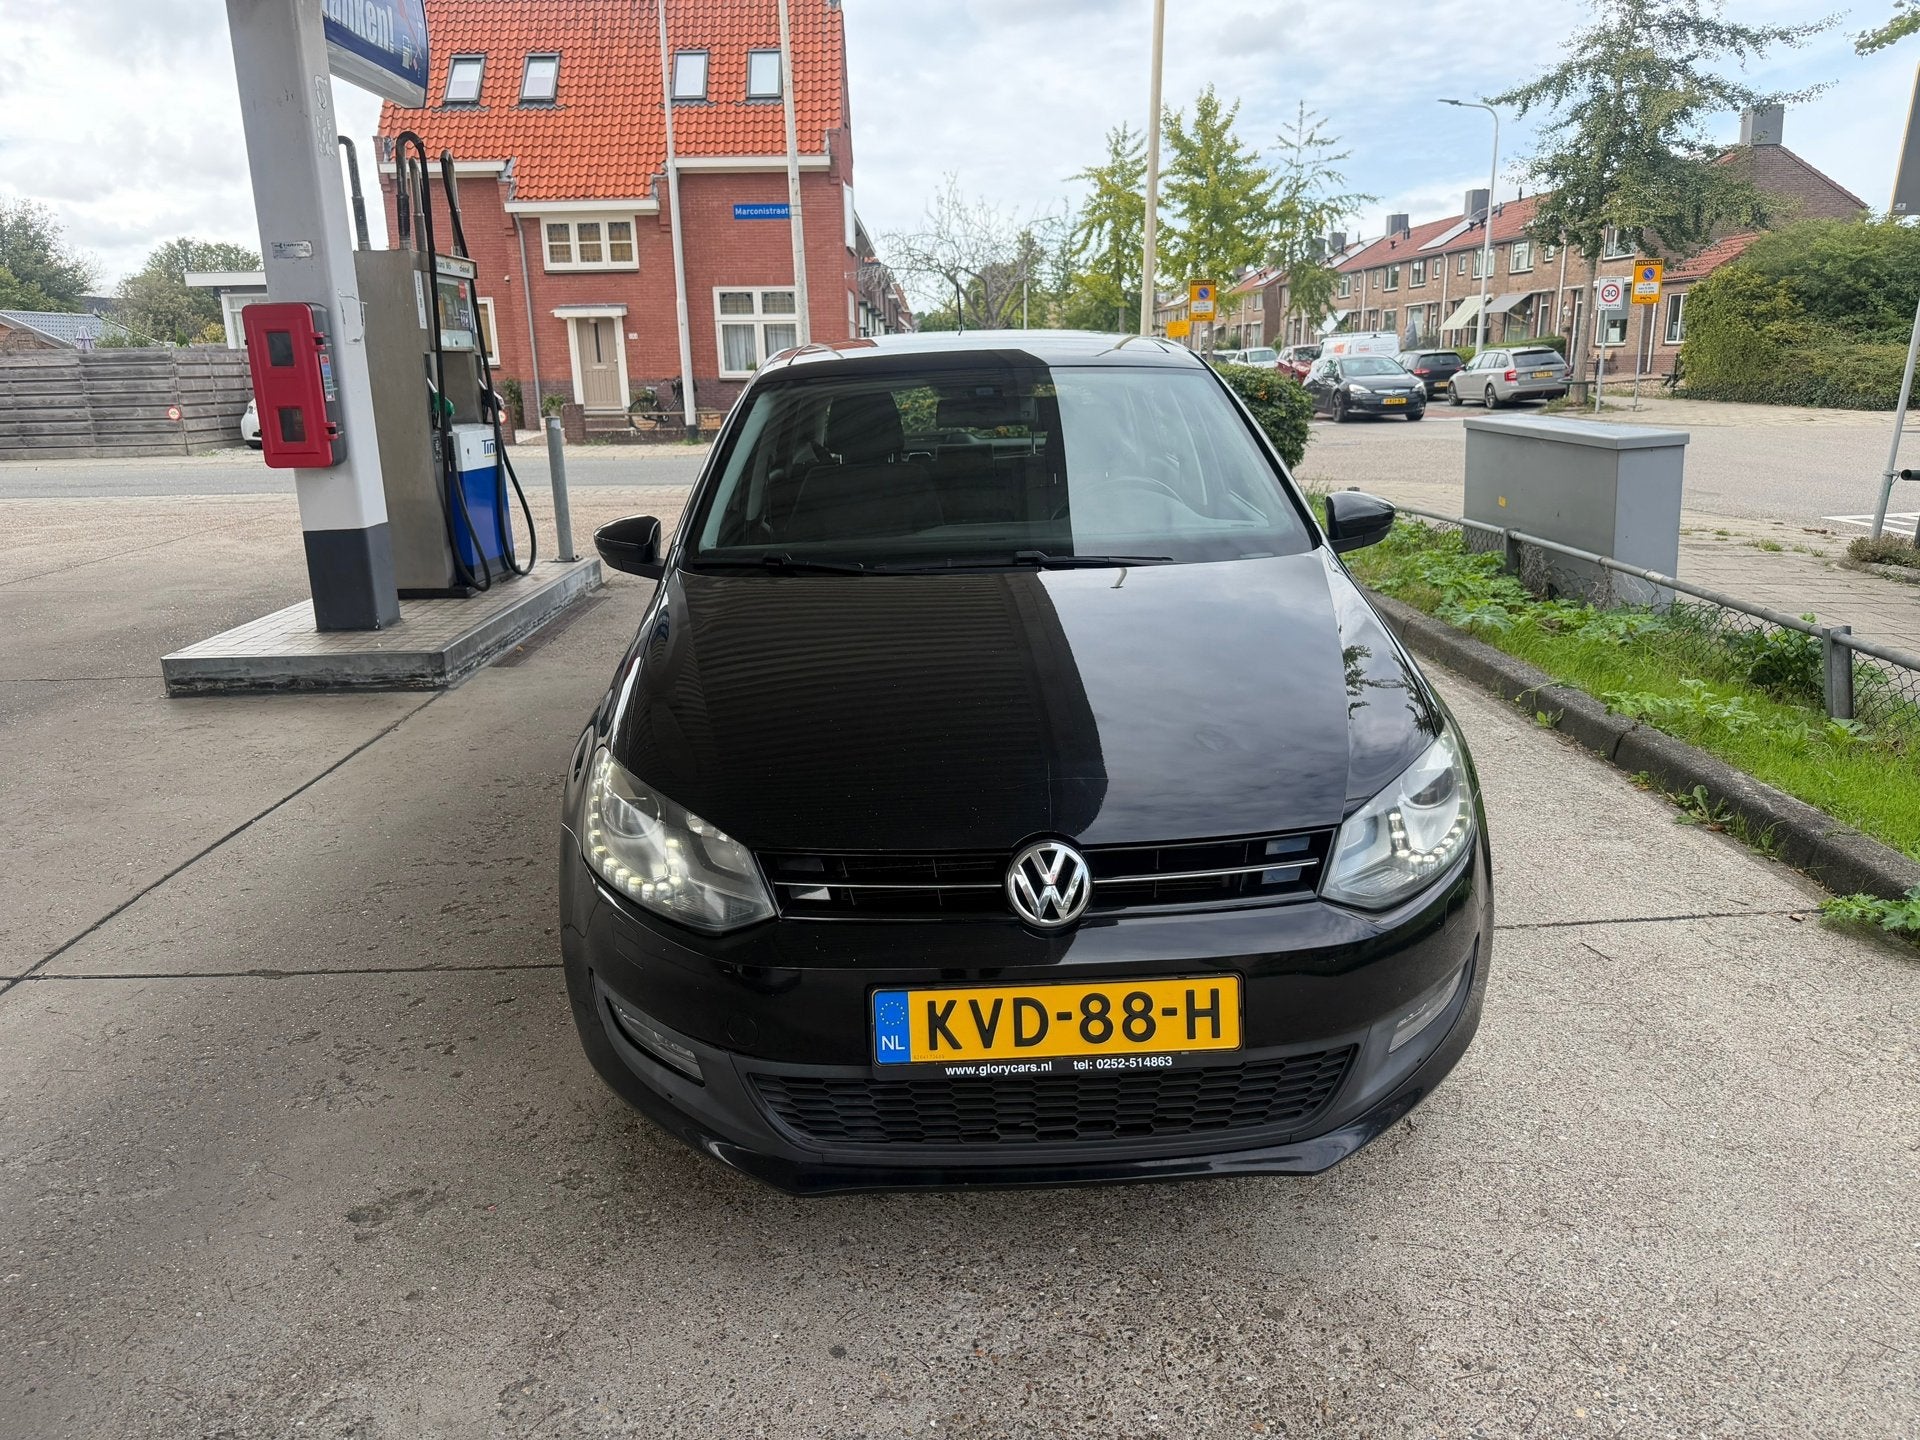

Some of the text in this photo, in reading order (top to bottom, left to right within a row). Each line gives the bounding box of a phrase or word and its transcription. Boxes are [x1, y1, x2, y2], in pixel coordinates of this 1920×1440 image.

[735, 207, 789, 215] Marconistraat
[1604, 289, 1617, 298] 30
[481, 439, 496, 455] Tin
[927, 988, 1221, 1051] KVD-88-H
[881, 1035, 906, 1051] NL
[945, 1056, 1173, 1076] www.glorycars.nl tel: 0252-514863
